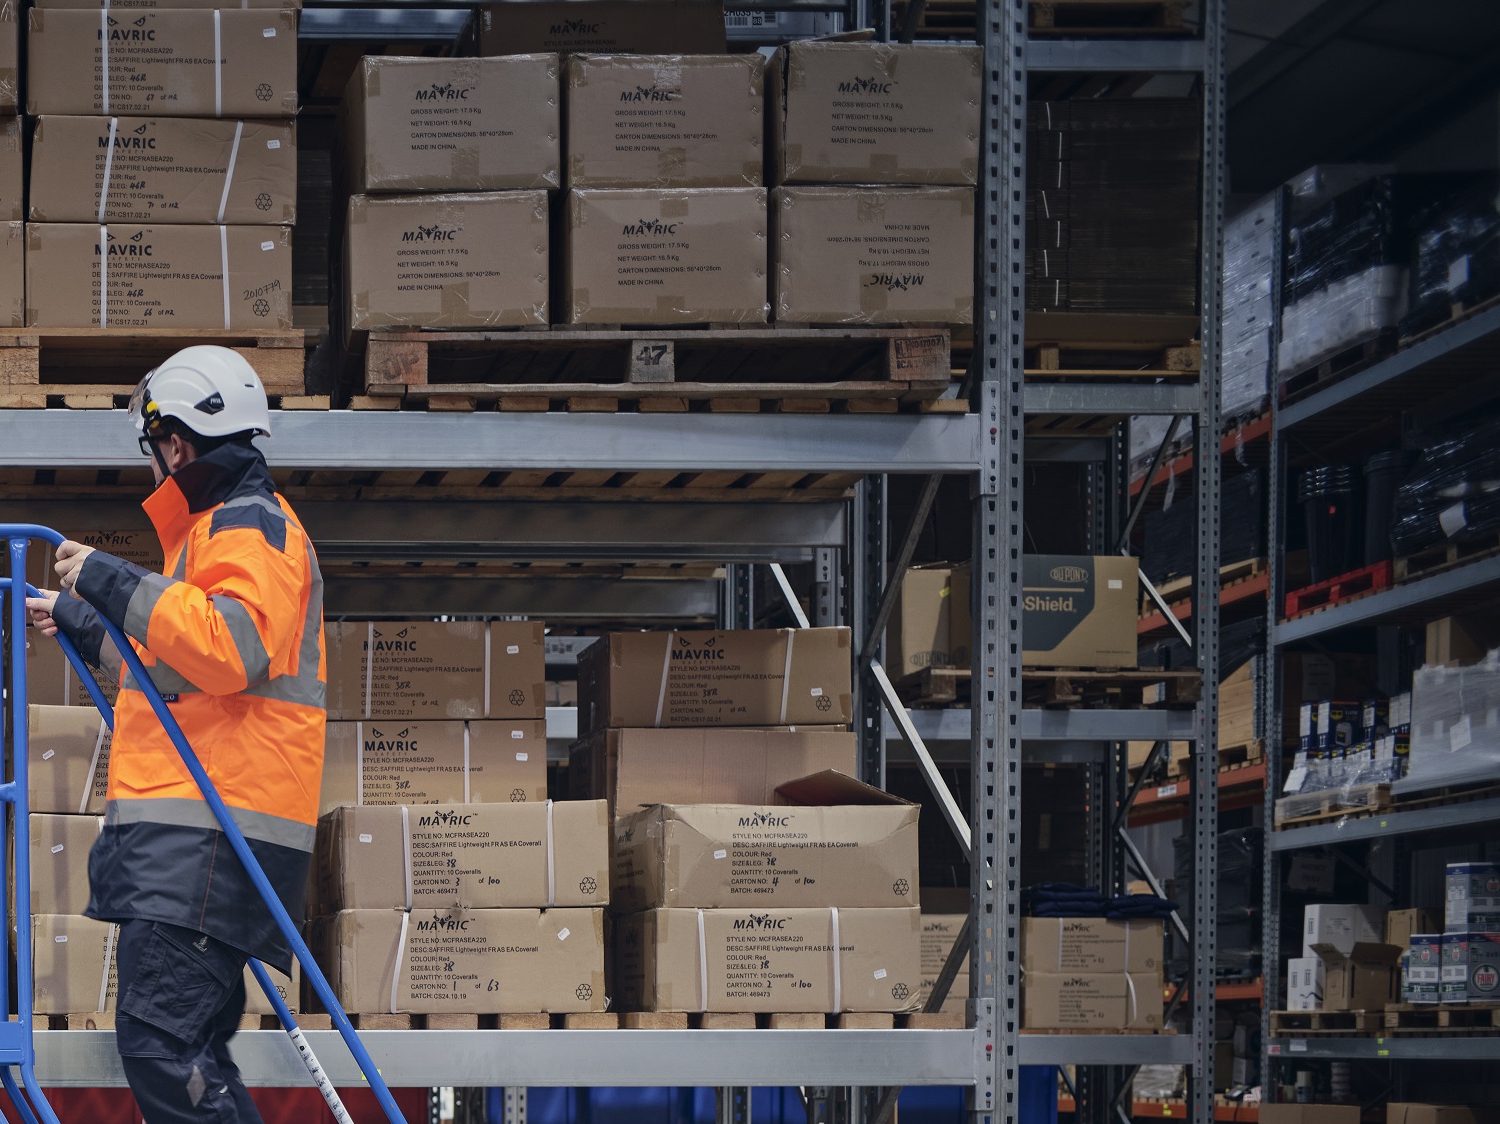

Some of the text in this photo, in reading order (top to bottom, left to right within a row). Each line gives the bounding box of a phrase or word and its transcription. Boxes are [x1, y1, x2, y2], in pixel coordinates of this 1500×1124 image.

[243, 279, 282, 301] 2010779
[636, 344, 668, 366] 47
[672, 650, 724, 659] MAVRIC
[365, 741, 418, 751] MAVRIC
